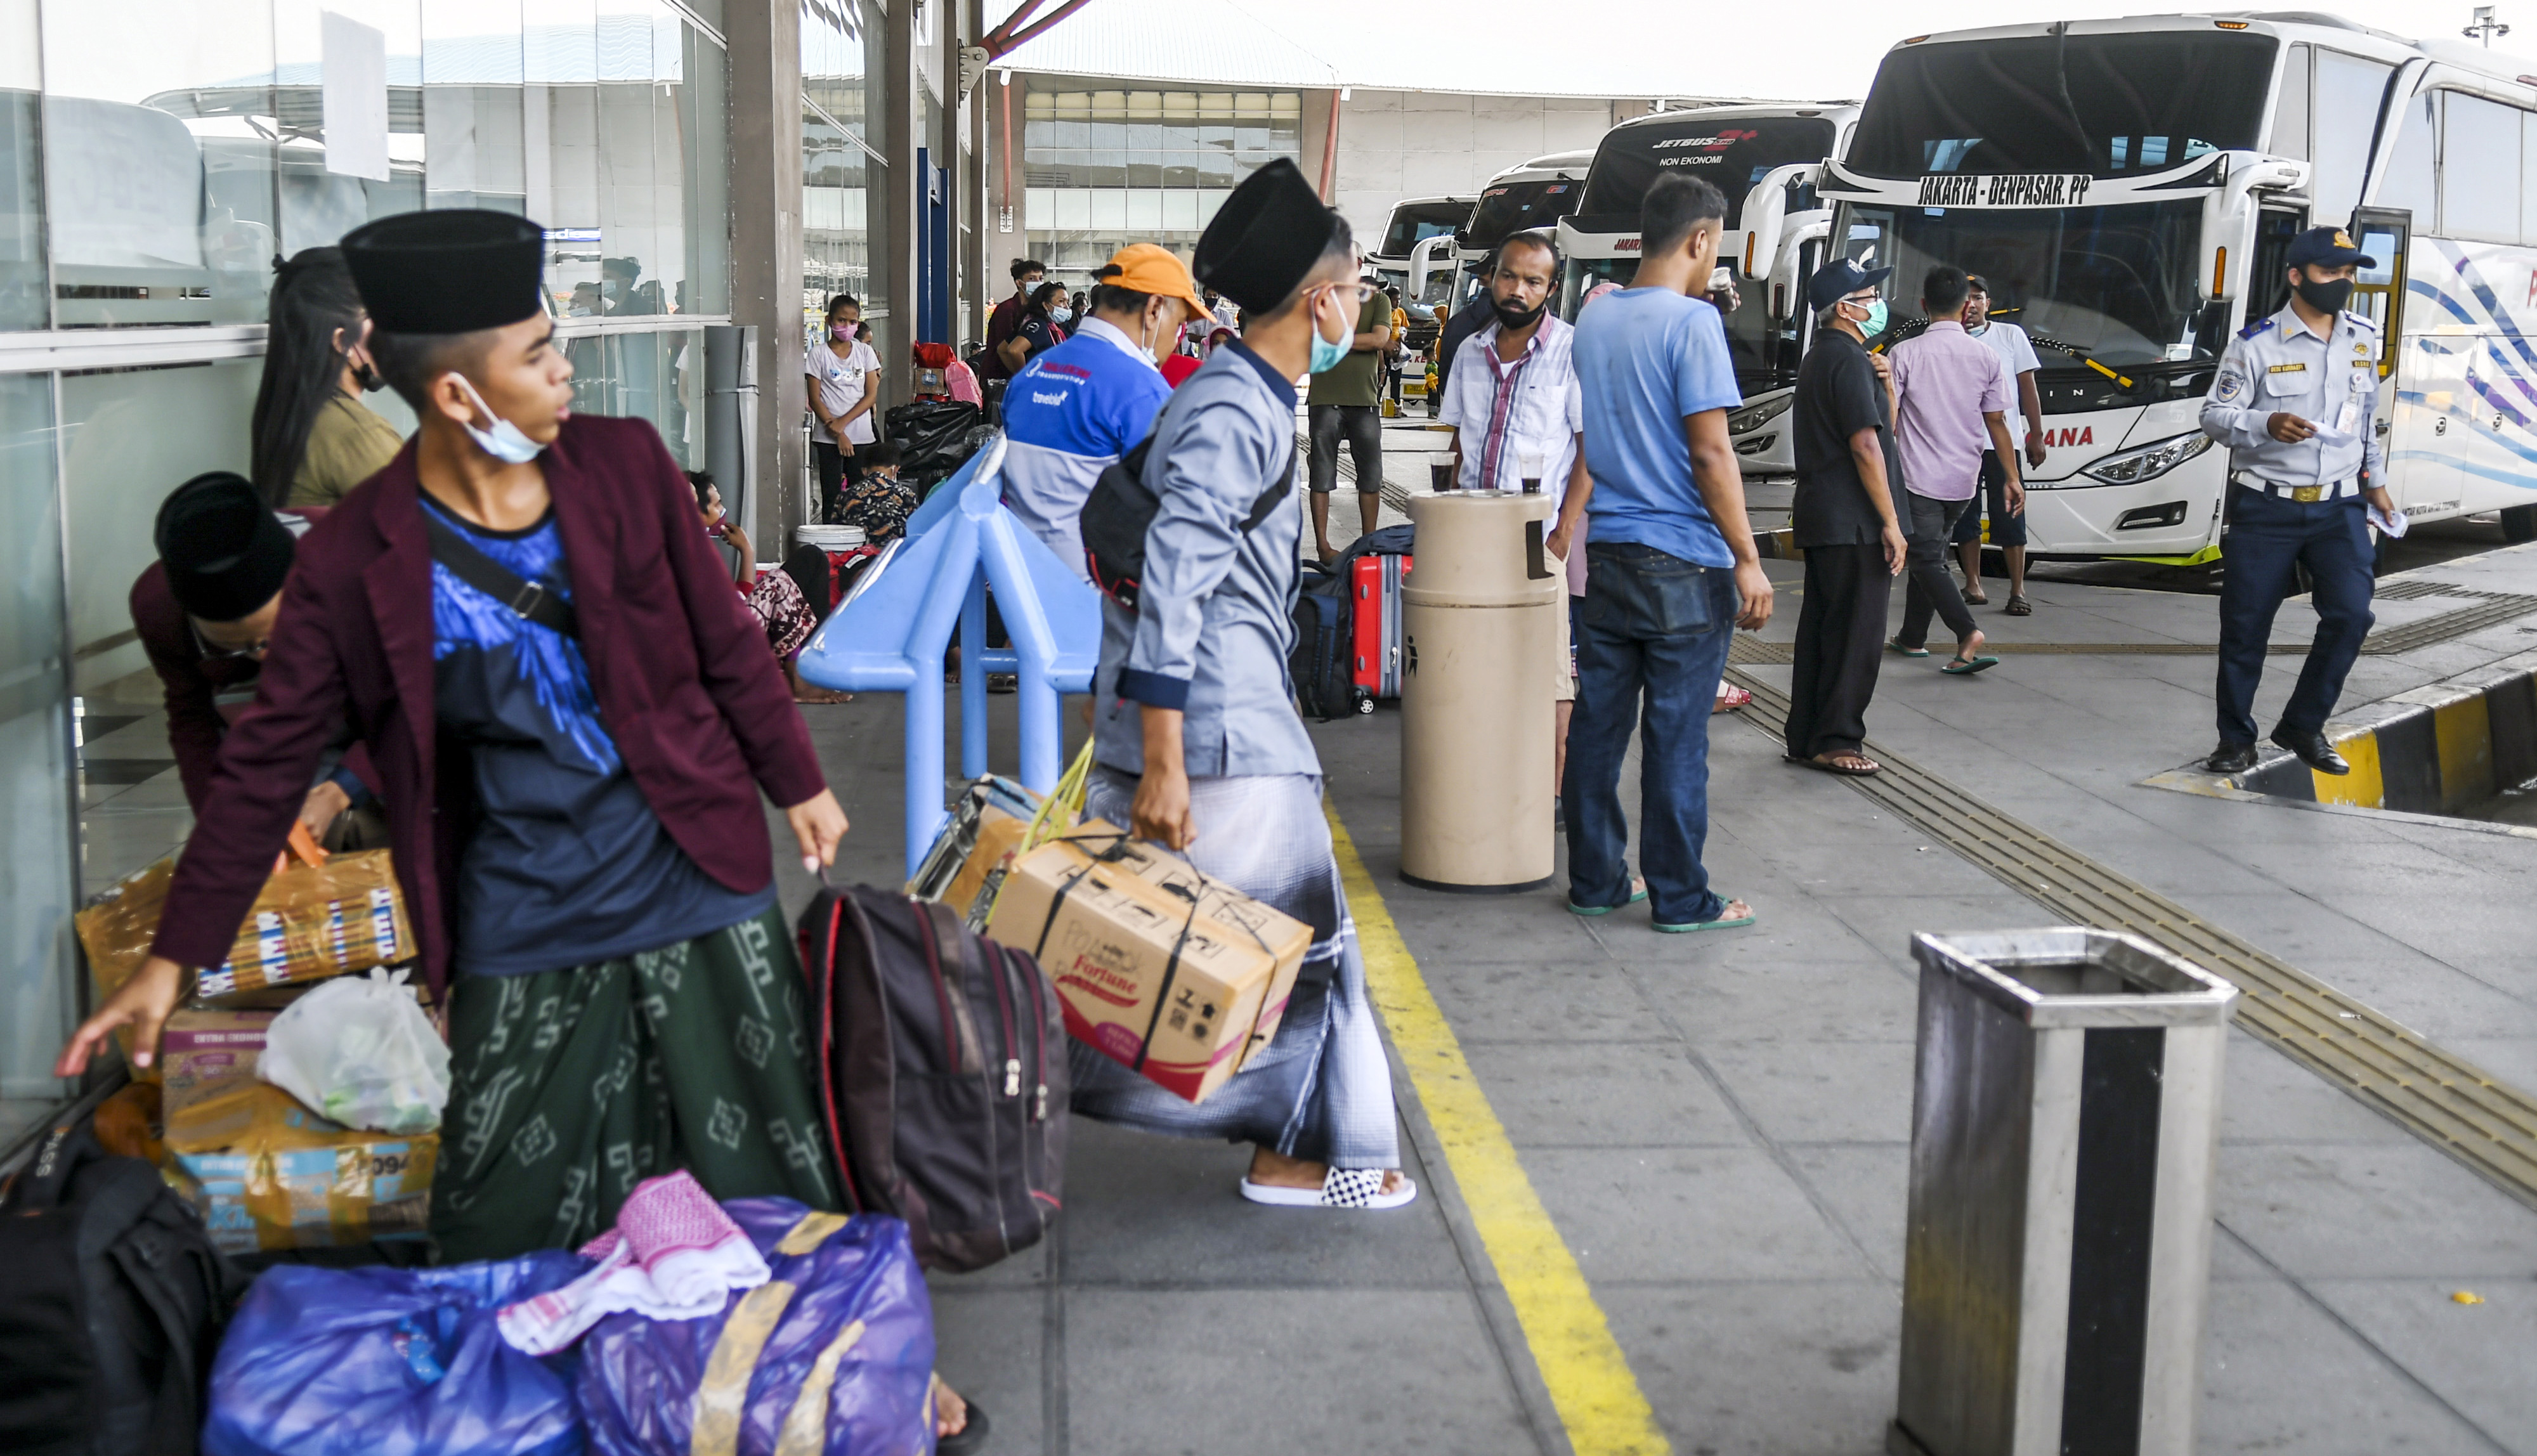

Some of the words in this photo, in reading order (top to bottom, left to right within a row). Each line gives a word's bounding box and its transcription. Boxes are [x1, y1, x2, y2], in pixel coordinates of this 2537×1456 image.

[1652, 138, 1717, 149] JETBUS
[1659, 157, 1679, 166] NON
[1680, 155, 1723, 166] EKONOMI
[1918, 176, 1978, 205] JAKARTA
[1988, 175, 2065, 205] DENPASAR.
[2068, 176, 2090, 204] PP
[1073, 954, 1137, 994] Fortune
